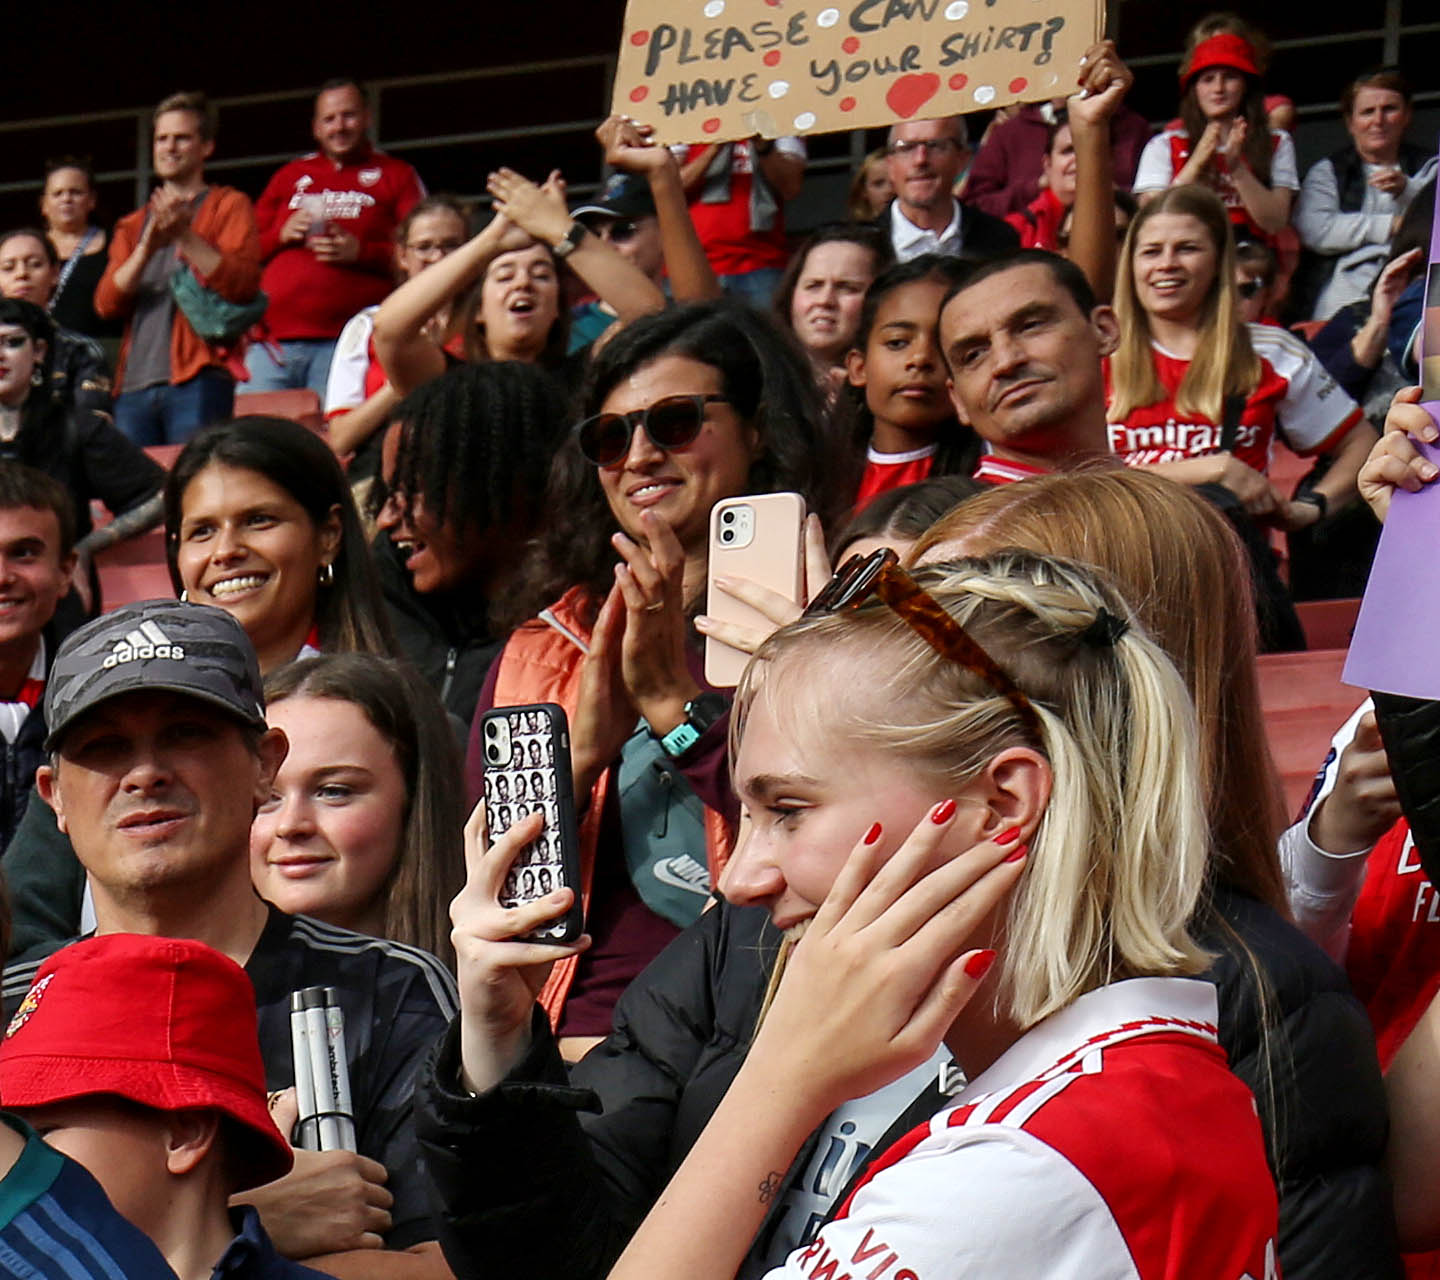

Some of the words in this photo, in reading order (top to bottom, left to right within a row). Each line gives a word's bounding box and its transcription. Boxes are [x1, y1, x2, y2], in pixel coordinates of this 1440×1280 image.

[645, 12, 809, 77] PLEASE
[658, 74, 762, 116] HAVE
[102, 642, 186, 670] adidas
